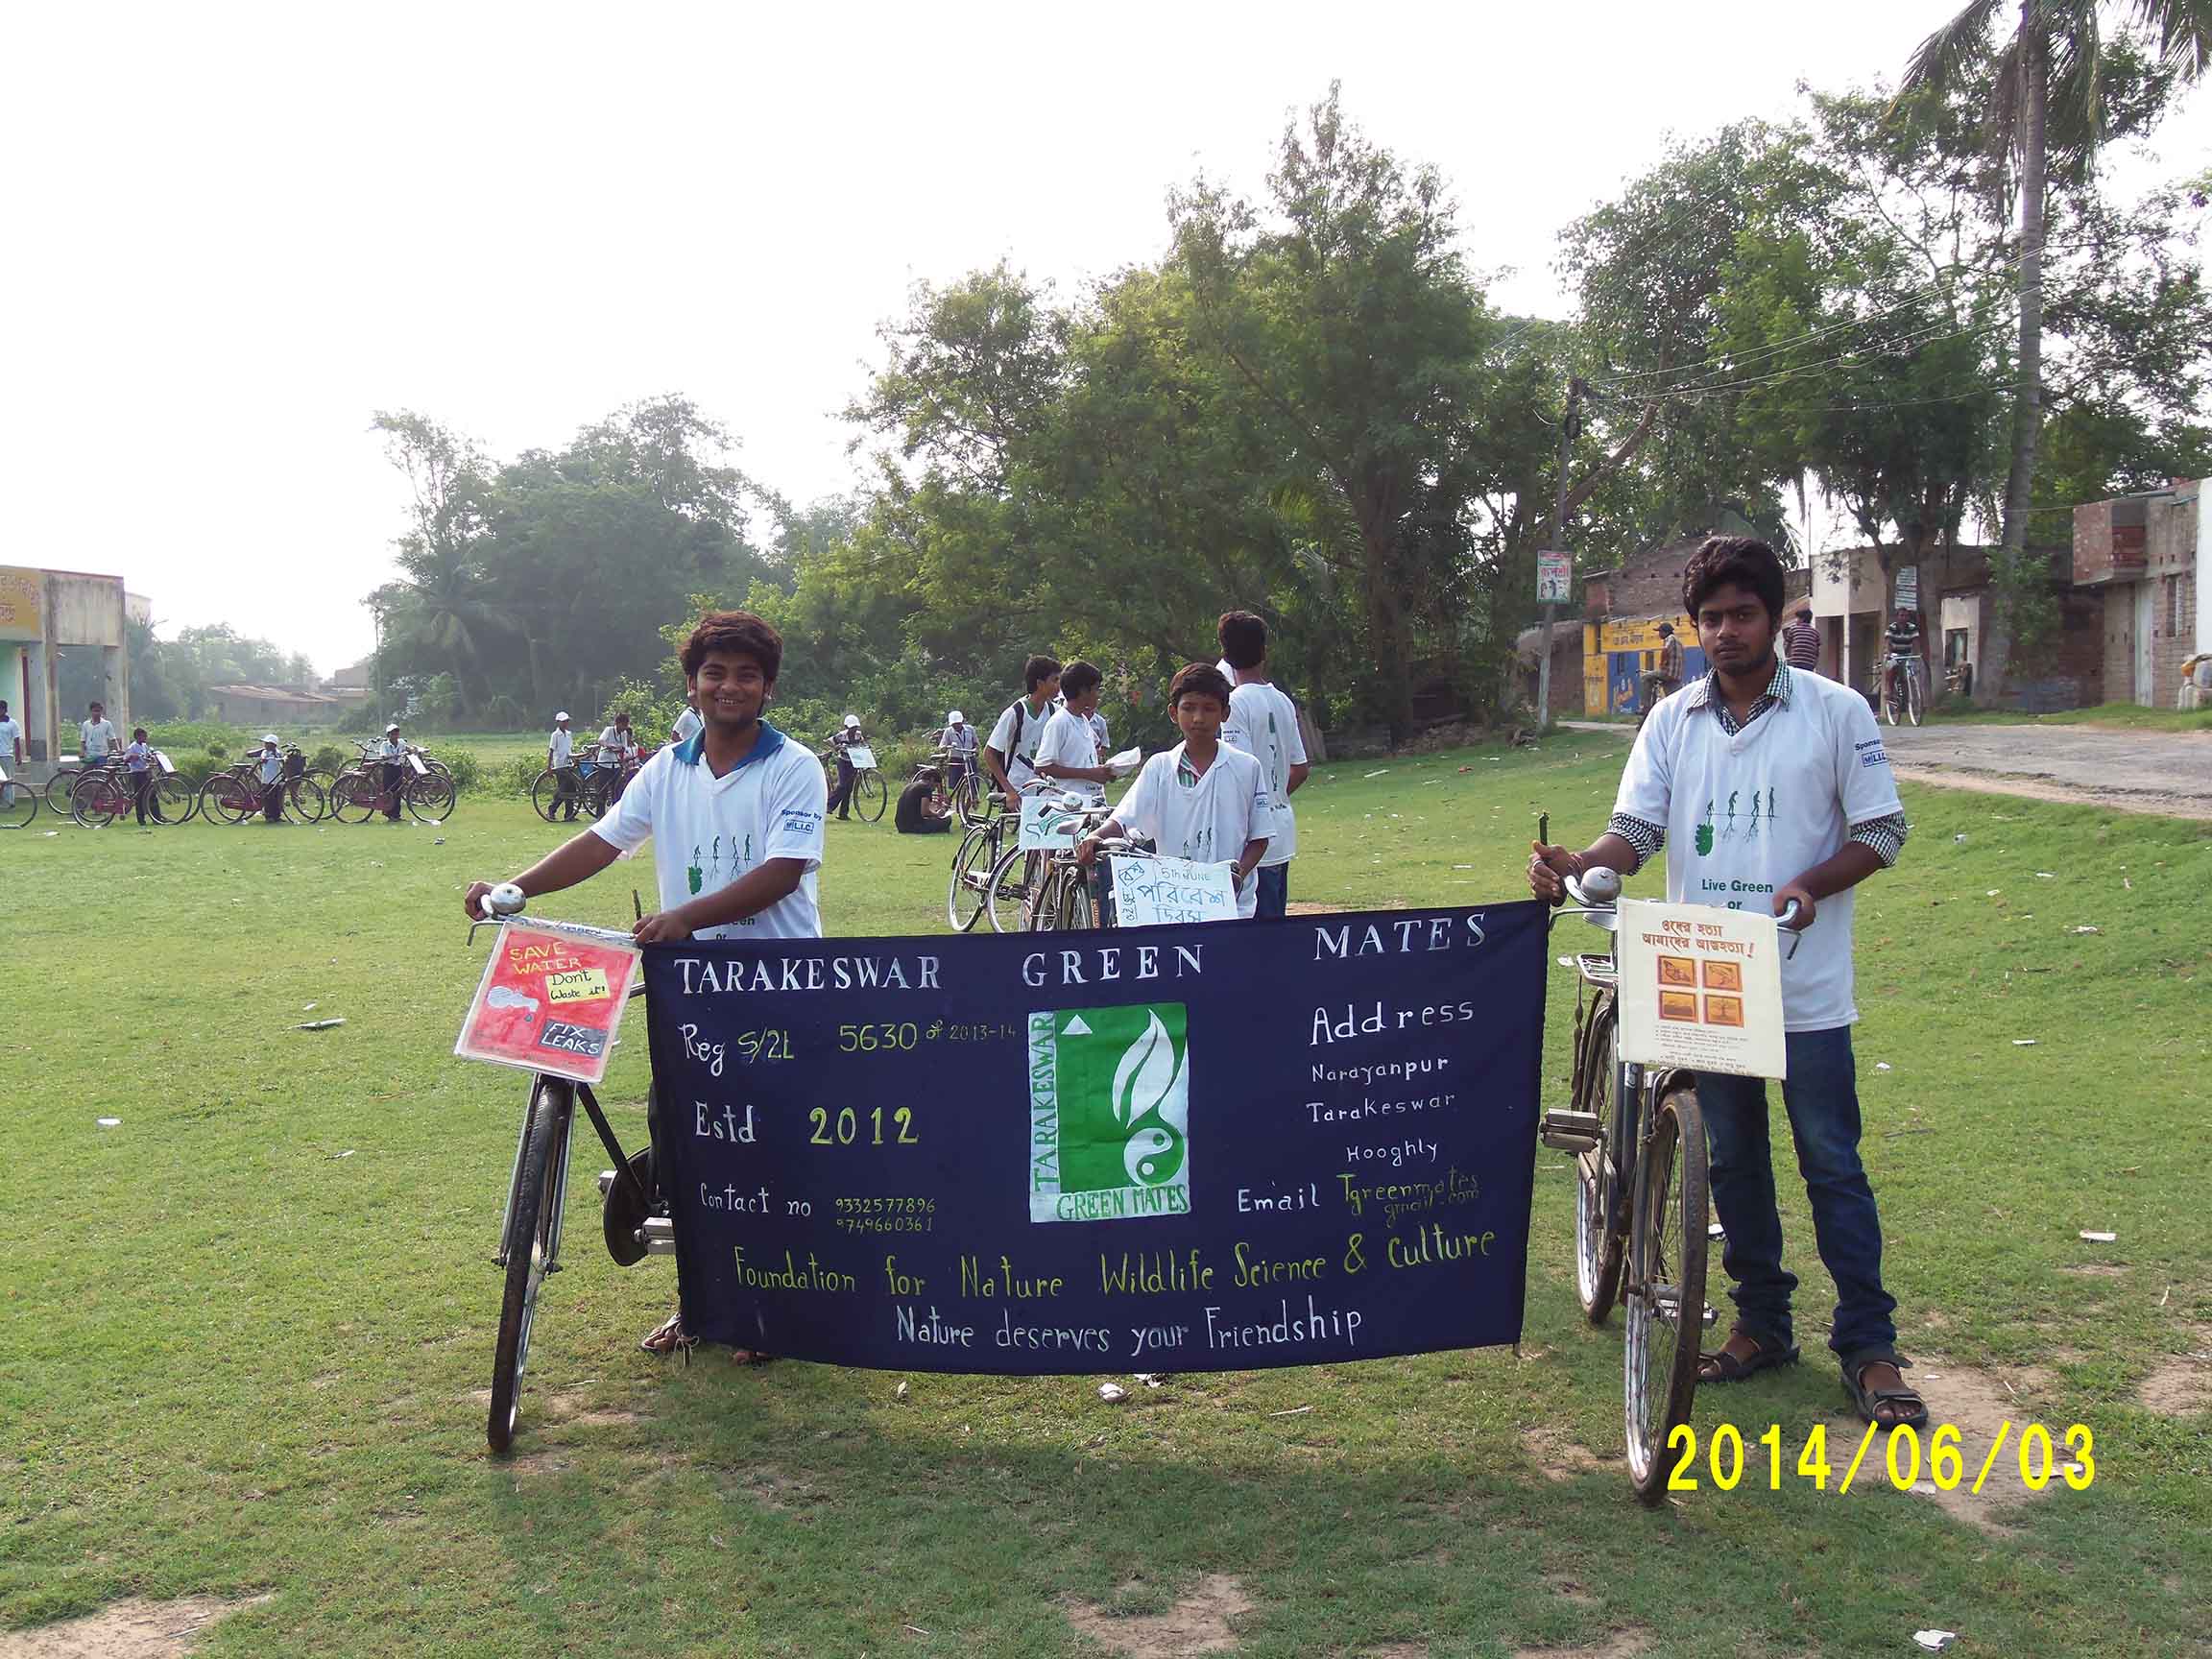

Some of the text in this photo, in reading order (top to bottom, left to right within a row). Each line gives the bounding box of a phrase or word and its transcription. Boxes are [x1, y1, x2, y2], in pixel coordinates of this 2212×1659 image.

[813, 812, 822, 821] by
[1701, 878, 1773, 893] Live Green
[1727, 901, 1743, 910] or
[1643, 932, 1691, 952] আমাদের
[1662, 920, 1722, 937] ওদের হত্যা
[510, 941, 568, 960] SAVE
[674, 912, 1486, 995] TARAKESWAR GREEN MATES
[514, 957, 581, 975] WATER
[548, 1022, 585, 1038] FIX
[1310, 1000, 1476, 1046] Address
[541, 1033, 599, 1054] LEAKS
[677, 1023, 725, 1076] Reg
[839, 1022, 918, 1052] 5630
[950, 1023, 1017, 1041] 2013-14
[1311, 1056, 1450, 1084] Narayanpur
[1031, 1016, 1060, 1192] TARAKESWAR
[694, 1100, 920, 1145] Estd 2012
[1346, 1139, 1438, 1166] Hooghly
[700, 1182, 935, 1217] Contact no 9332577896
[1056, 1183, 1190, 1220] GREEN MATES
[1237, 1184, 1321, 1214] Email
[733, 1222, 1498, 1298] Foundation for Nature Wildlife Science & Culture
[896, 1294, 1362, 1358] Nature deserves your Friendship
